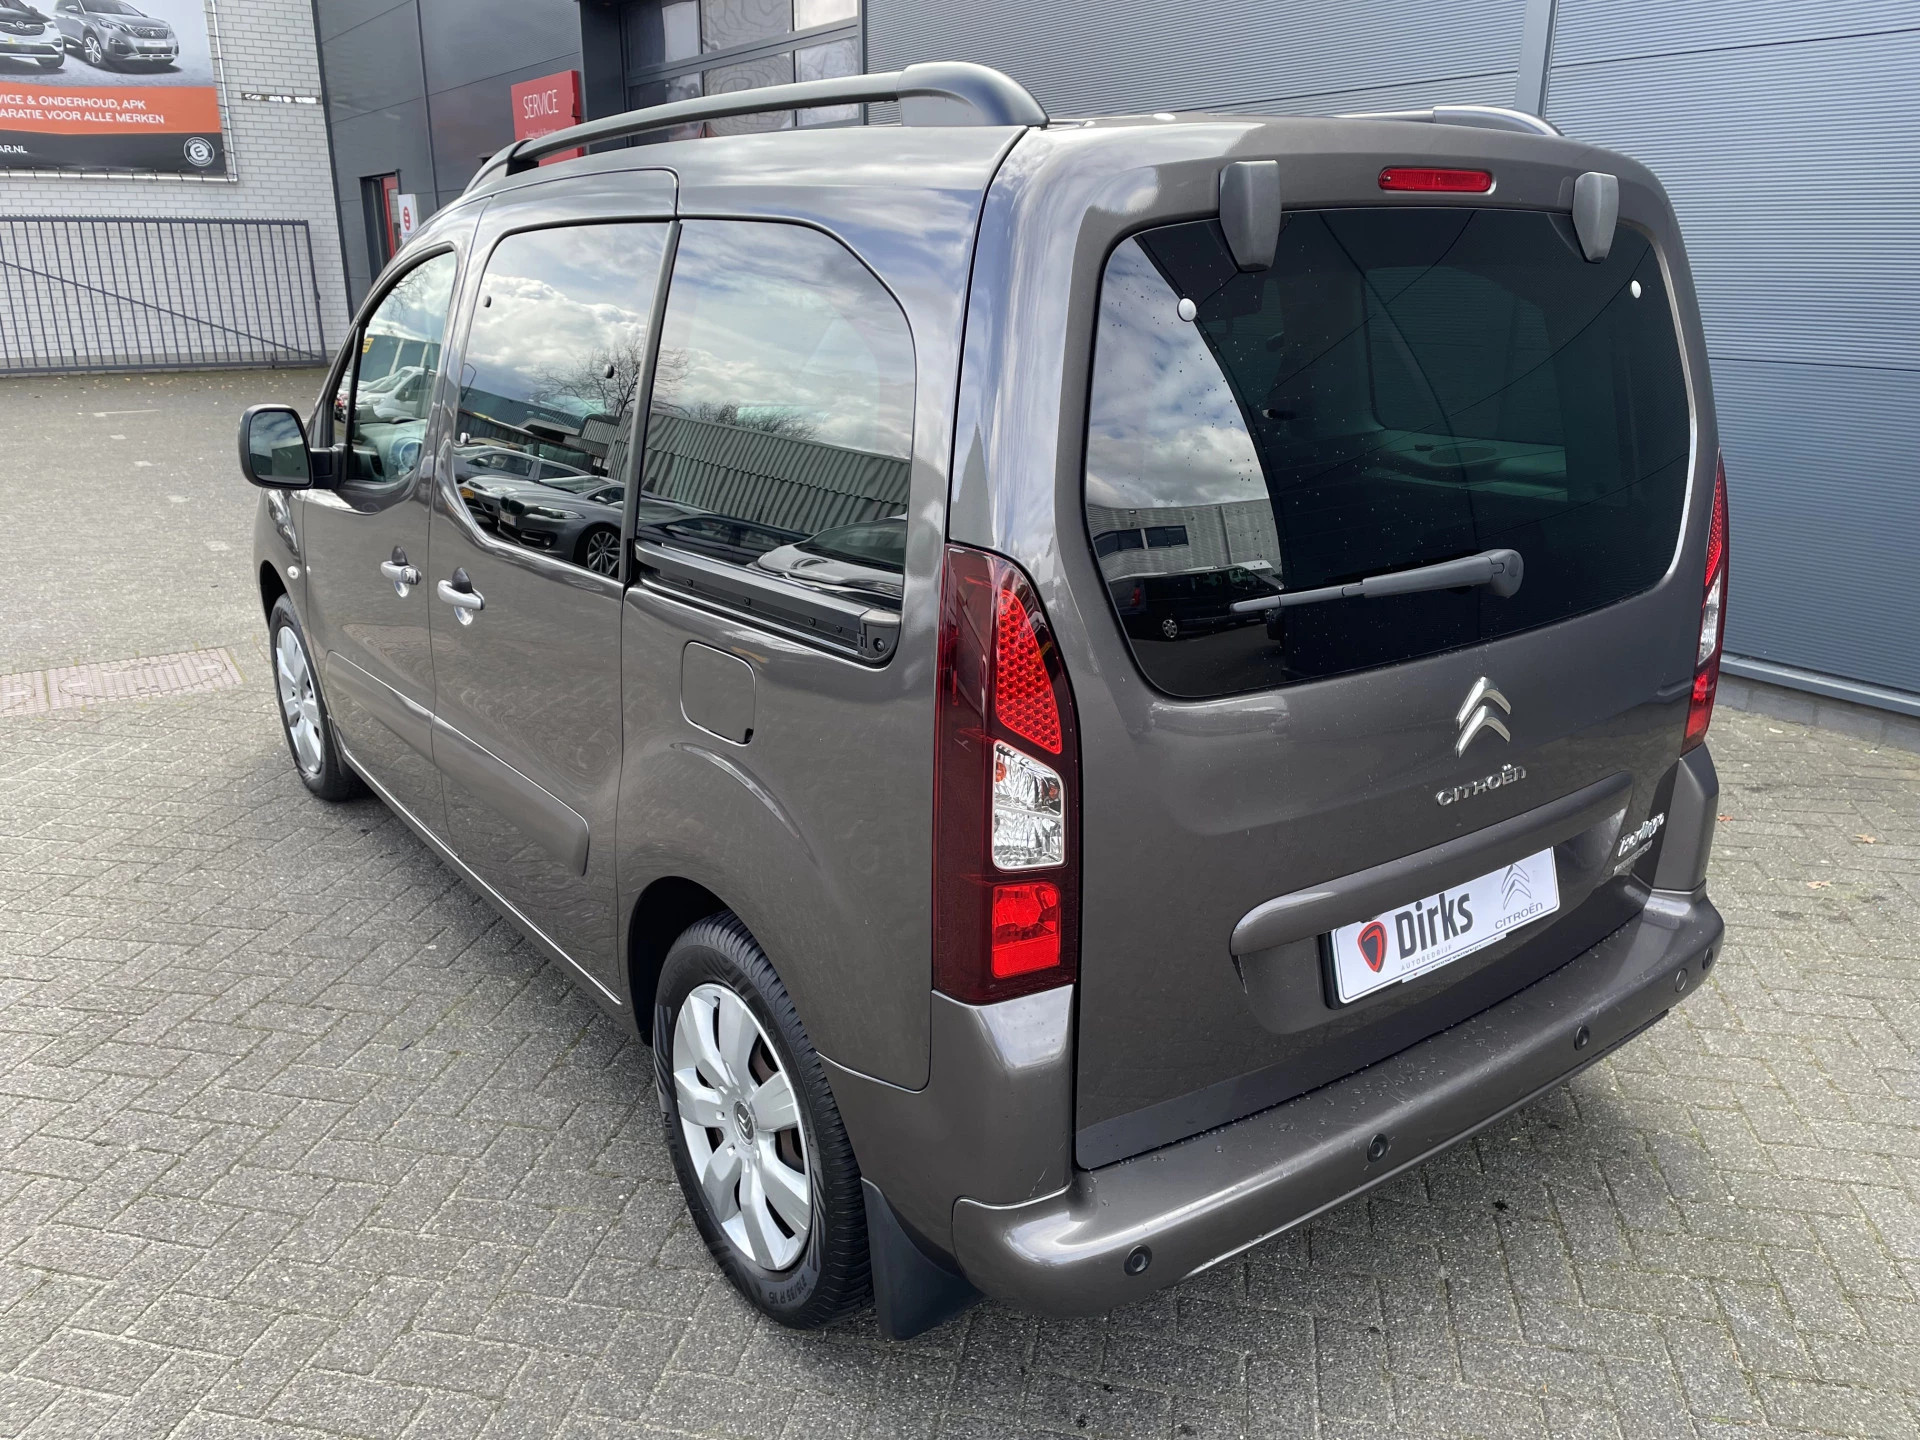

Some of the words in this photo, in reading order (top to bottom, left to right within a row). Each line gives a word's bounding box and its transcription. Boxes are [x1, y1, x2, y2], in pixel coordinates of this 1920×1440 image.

[26, 95, 36, 105] &
[38, 95, 120, 110] ONDERHOUD,
[122, 99, 146, 110] APK
[44, 110, 82, 121] VOOR
[83, 111, 114, 122] ALLE
[115, 112, 165, 124] MERKEN
[522, 89, 560, 119] SERVICE
[1435, 763, 1527, 806] CITROËN
[1395, 892, 1474, 960] Dirks
[1494, 901, 1544, 931] CITROËN
[1401, 944, 1453, 971] AUTOBEDRIJF
